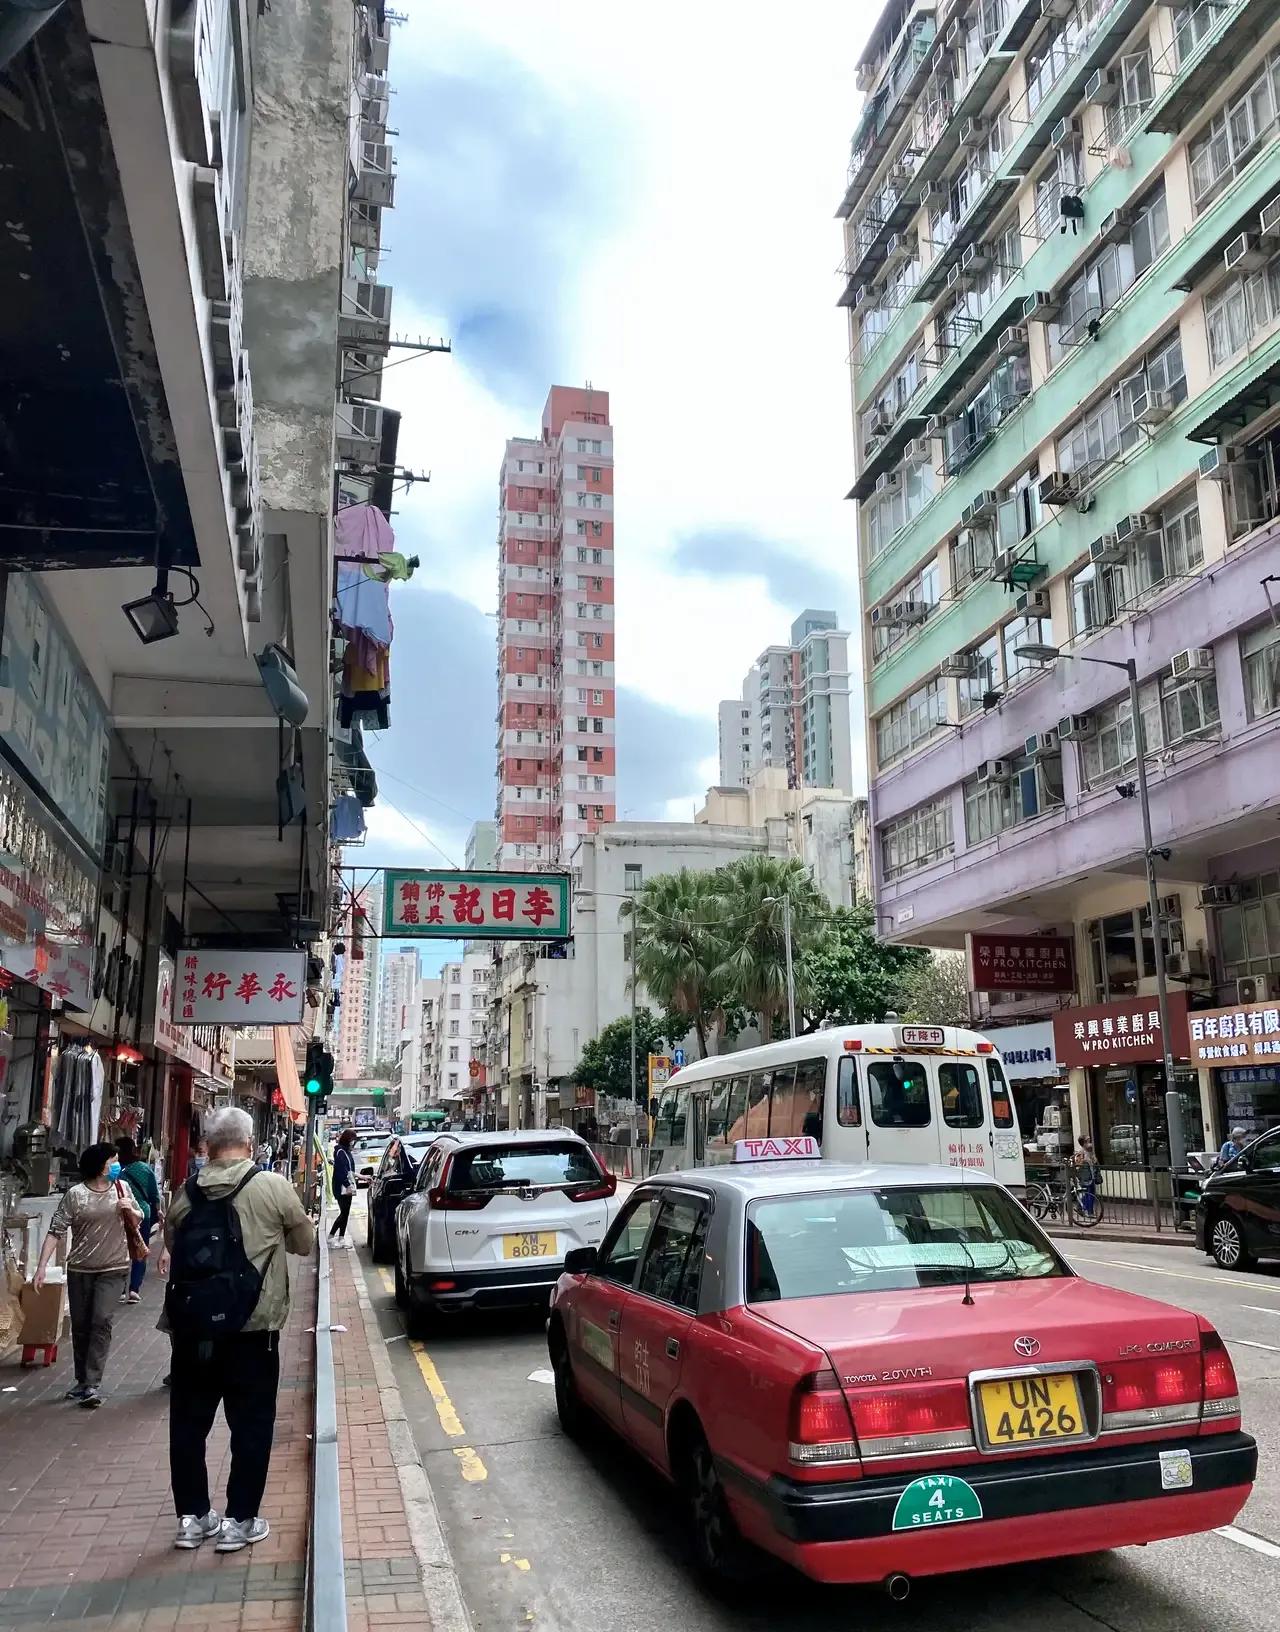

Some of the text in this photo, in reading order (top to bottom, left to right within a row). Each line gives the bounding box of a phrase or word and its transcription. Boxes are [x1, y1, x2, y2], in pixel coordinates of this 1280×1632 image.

[449, 883, 555, 926] 李日記
[980, 959, 1067, 969] W PRO KITCHEN
[202, 971, 298, 1004] 永華行
[906, 1030, 940, 1041] 升降中
[1082, 1033, 1154, 1052] W PRO KITCHEN
[744, 1138, 813, 1157] TAXI
[455, 1228, 480, 1236] CR-V
[520, 1233, 539, 1245] XM
[512, 1243, 548, 1257] 8087
[1119, 1338, 1197, 1356] LPG COMFORT
[844, 1374, 878, 1383] TOYOTA
[1007, 1377, 1052, 1410] UN
[996, 1404, 1077, 1441] 4426
[917, 1476, 953, 1490] TAXI
[928, 1488, 946, 1509] 4
[911, 1507, 964, 1524] SEATS
